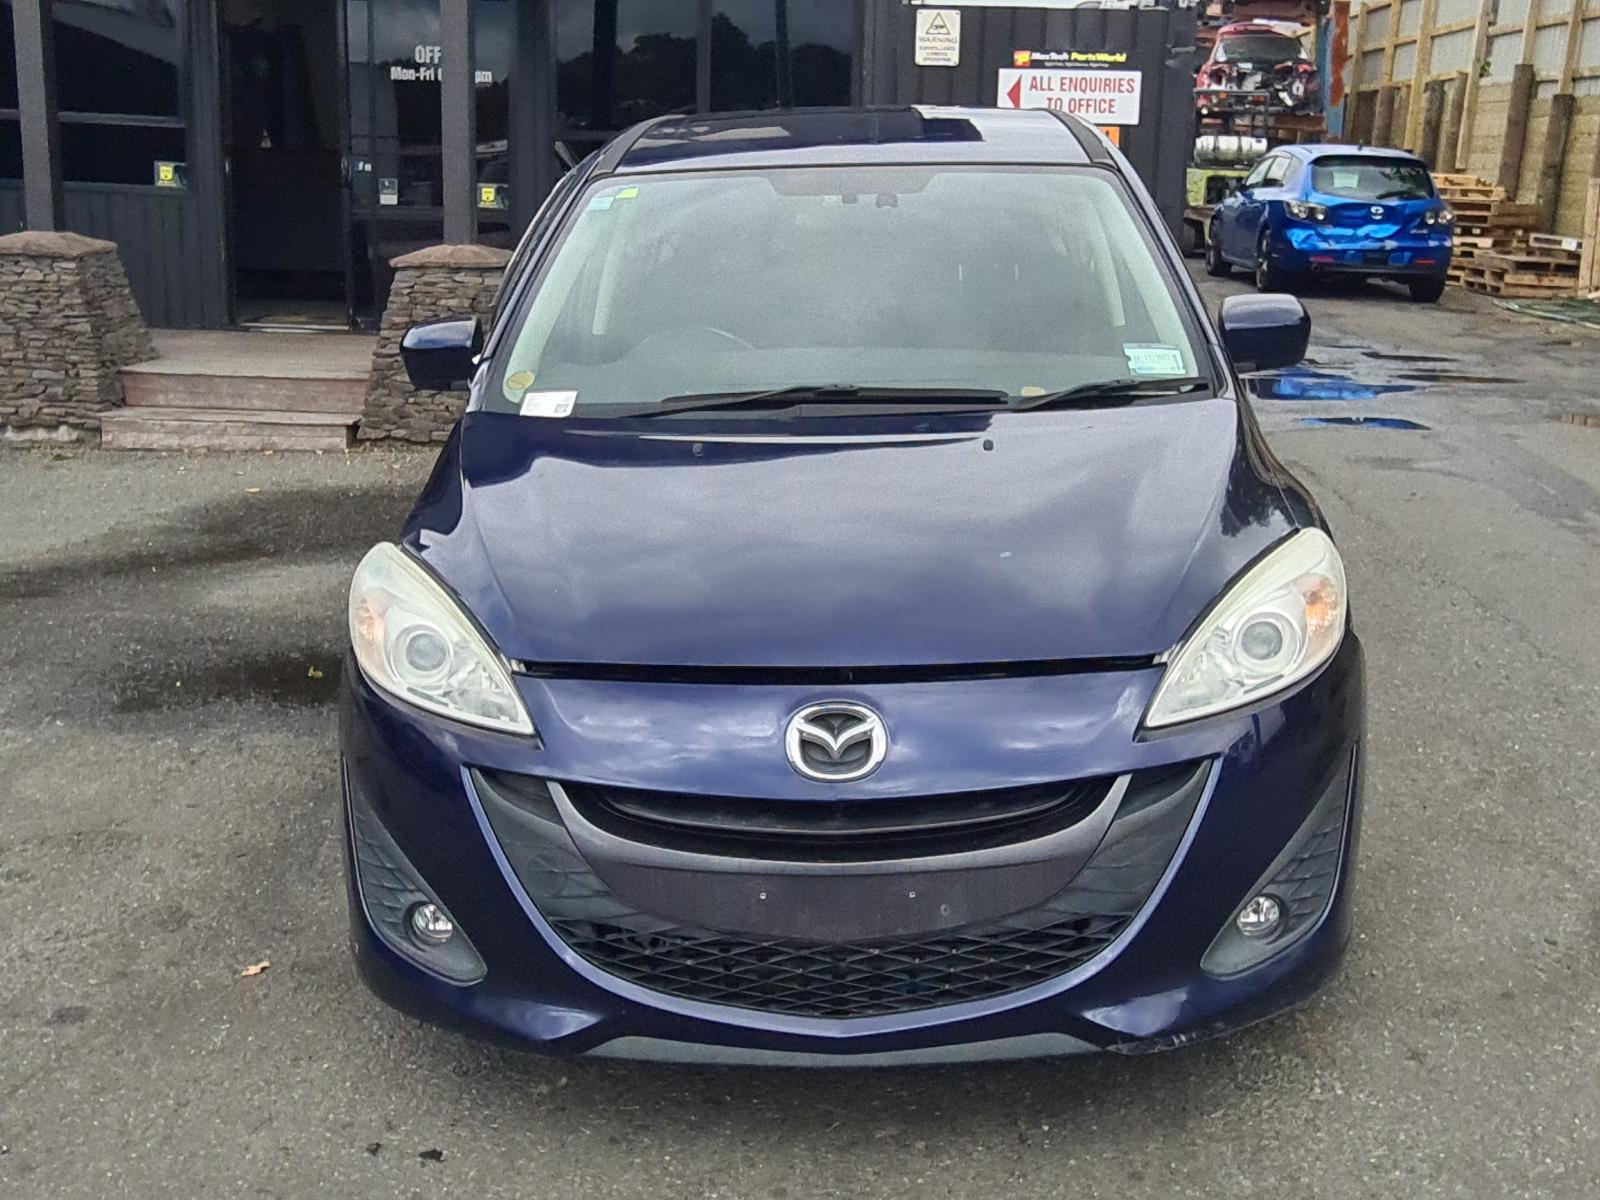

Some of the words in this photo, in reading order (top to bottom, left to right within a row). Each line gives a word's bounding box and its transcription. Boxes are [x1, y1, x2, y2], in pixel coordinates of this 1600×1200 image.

[414, 44, 442, 64] OFF
[1029, 76, 1055, 92] ALL
[1059, 76, 1136, 94] ENQUIRIES
[1046, 97, 1063, 111] TO
[1068, 98, 1116, 114] OFFICE
